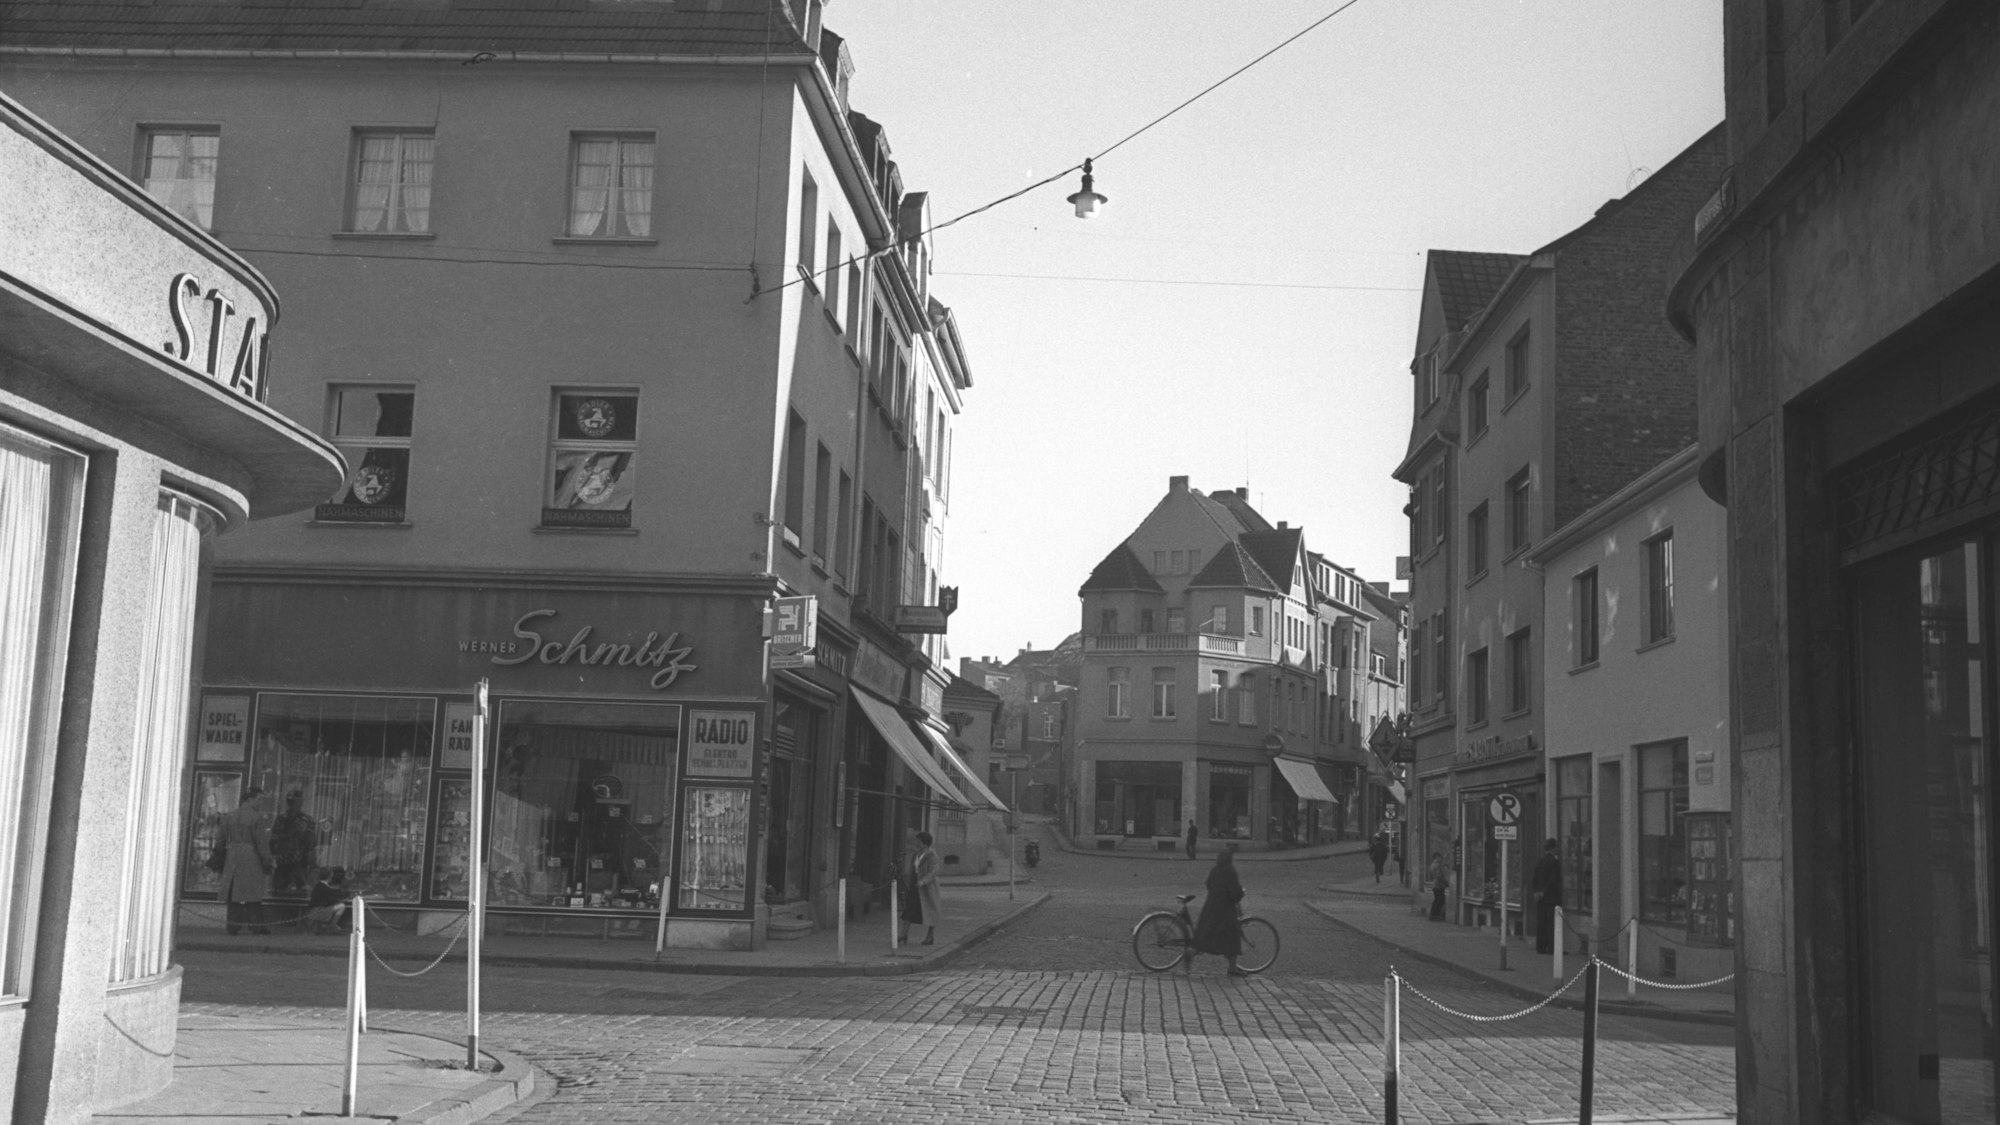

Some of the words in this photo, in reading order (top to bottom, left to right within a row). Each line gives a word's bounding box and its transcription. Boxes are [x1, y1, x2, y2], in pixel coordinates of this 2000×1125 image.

[163, 272, 269, 405] STA
[458, 640, 517, 654] WERNER
[491, 609, 697, 690] Schmitz
[208, 712, 243, 727] SPIEL-
[451, 719, 474, 734] FAH
[206, 730, 242, 744] WAREN
[695, 718, 748, 745] RADIO
[448, 736, 472, 751] RÄD
